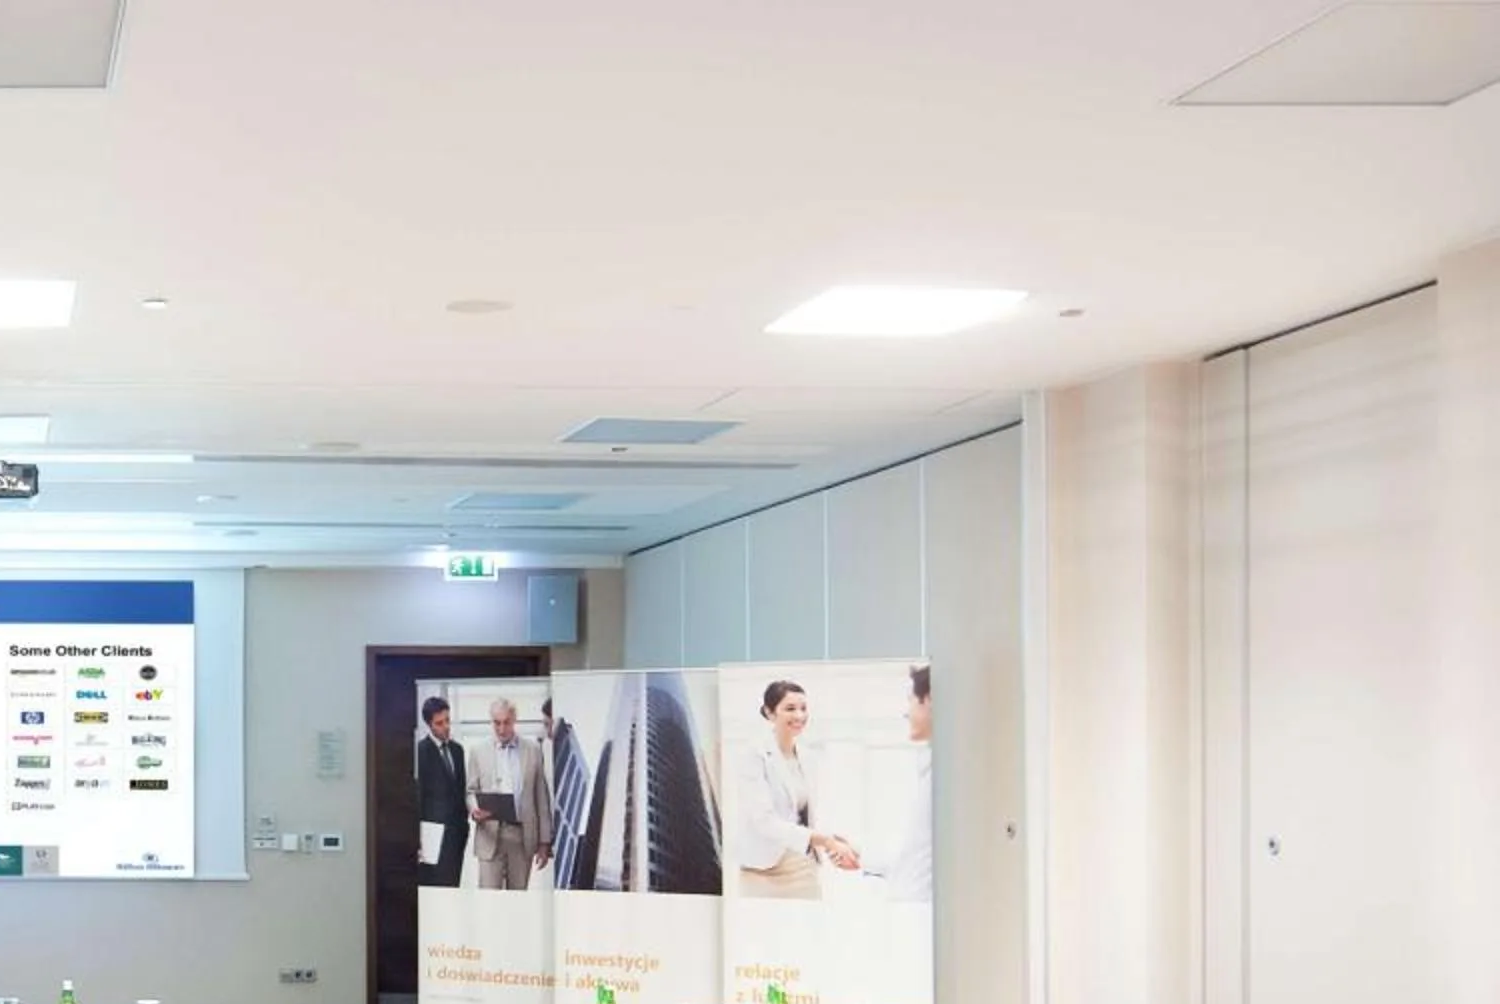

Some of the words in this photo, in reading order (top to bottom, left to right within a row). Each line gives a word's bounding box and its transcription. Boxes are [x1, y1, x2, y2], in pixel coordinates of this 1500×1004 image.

[9, 645, 52, 657] Some
[55, 645, 98, 657] Other
[101, 645, 153, 657] Clients
[426, 943, 482, 961] wiedza
[564, 948, 660, 974] inwestycje
[734, 962, 800, 986] relacje
